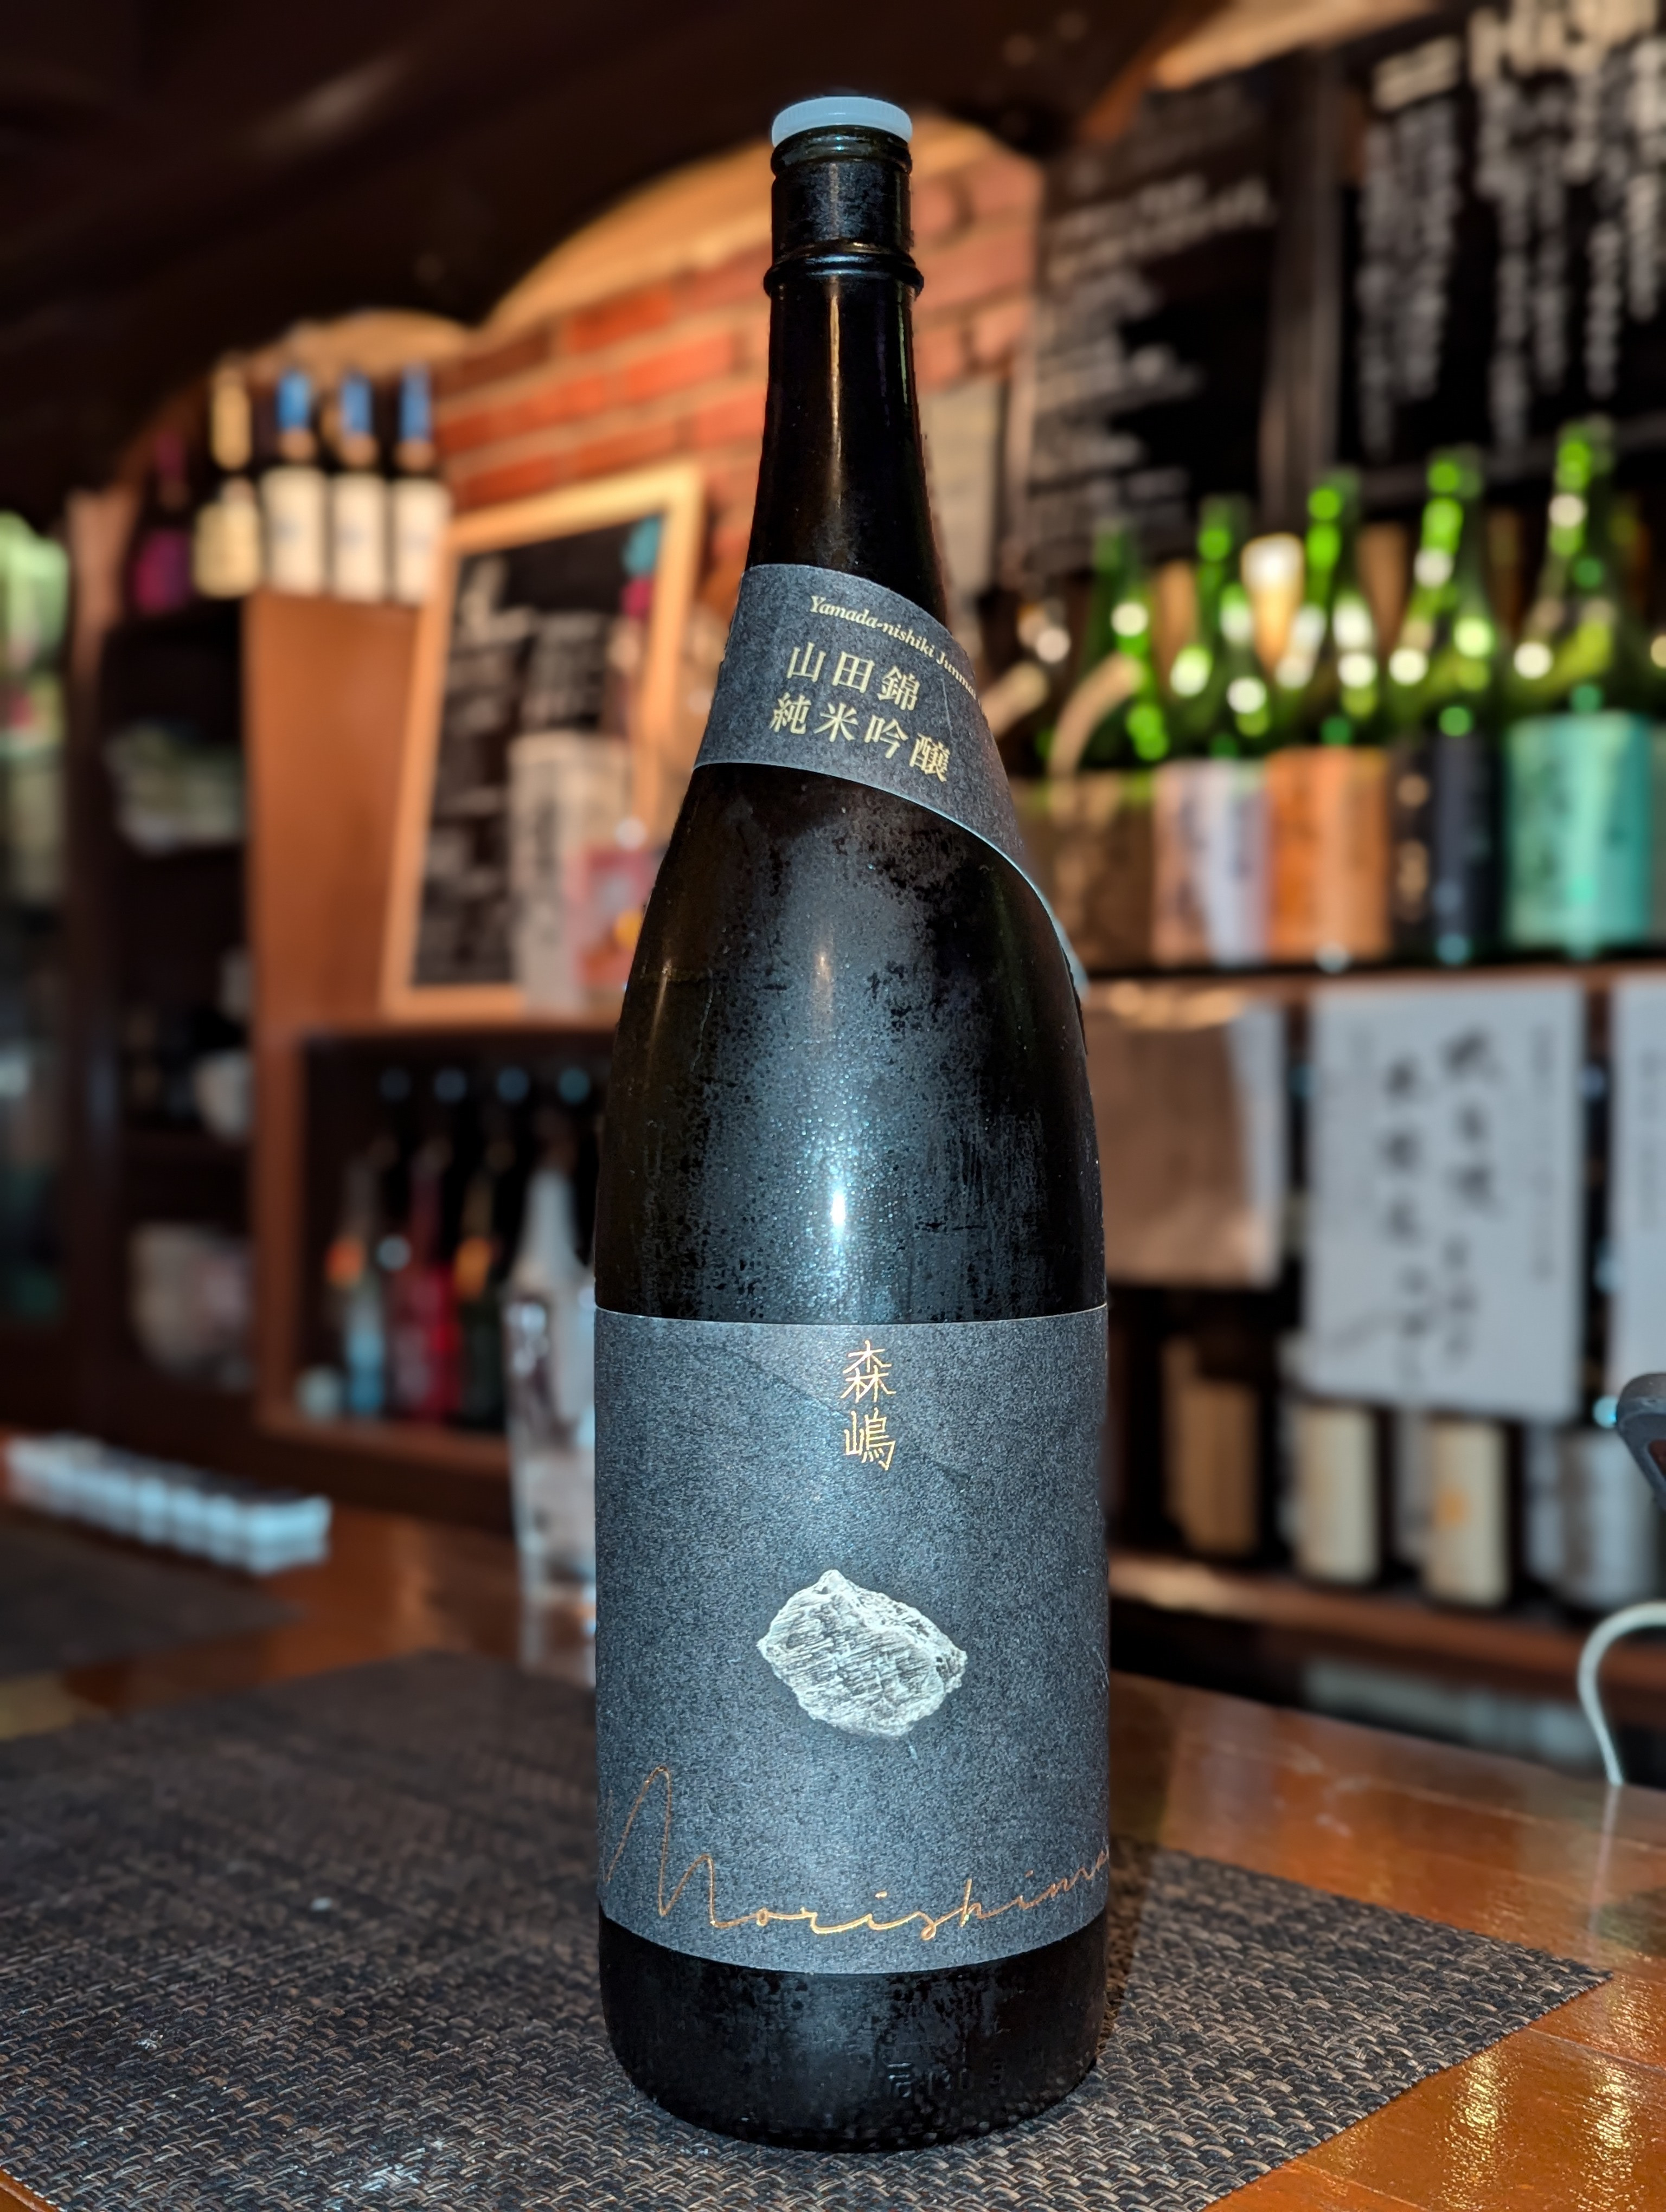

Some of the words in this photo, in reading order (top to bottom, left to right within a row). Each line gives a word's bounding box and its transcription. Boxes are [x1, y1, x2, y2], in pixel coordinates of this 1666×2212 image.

[810, 595, 935, 658] Yamada-nishiki
[786, 641, 920, 711] 山田錦
[769, 692, 950, 782] 純米吟醸
[840, 1339, 896, 1471] 森嶋
